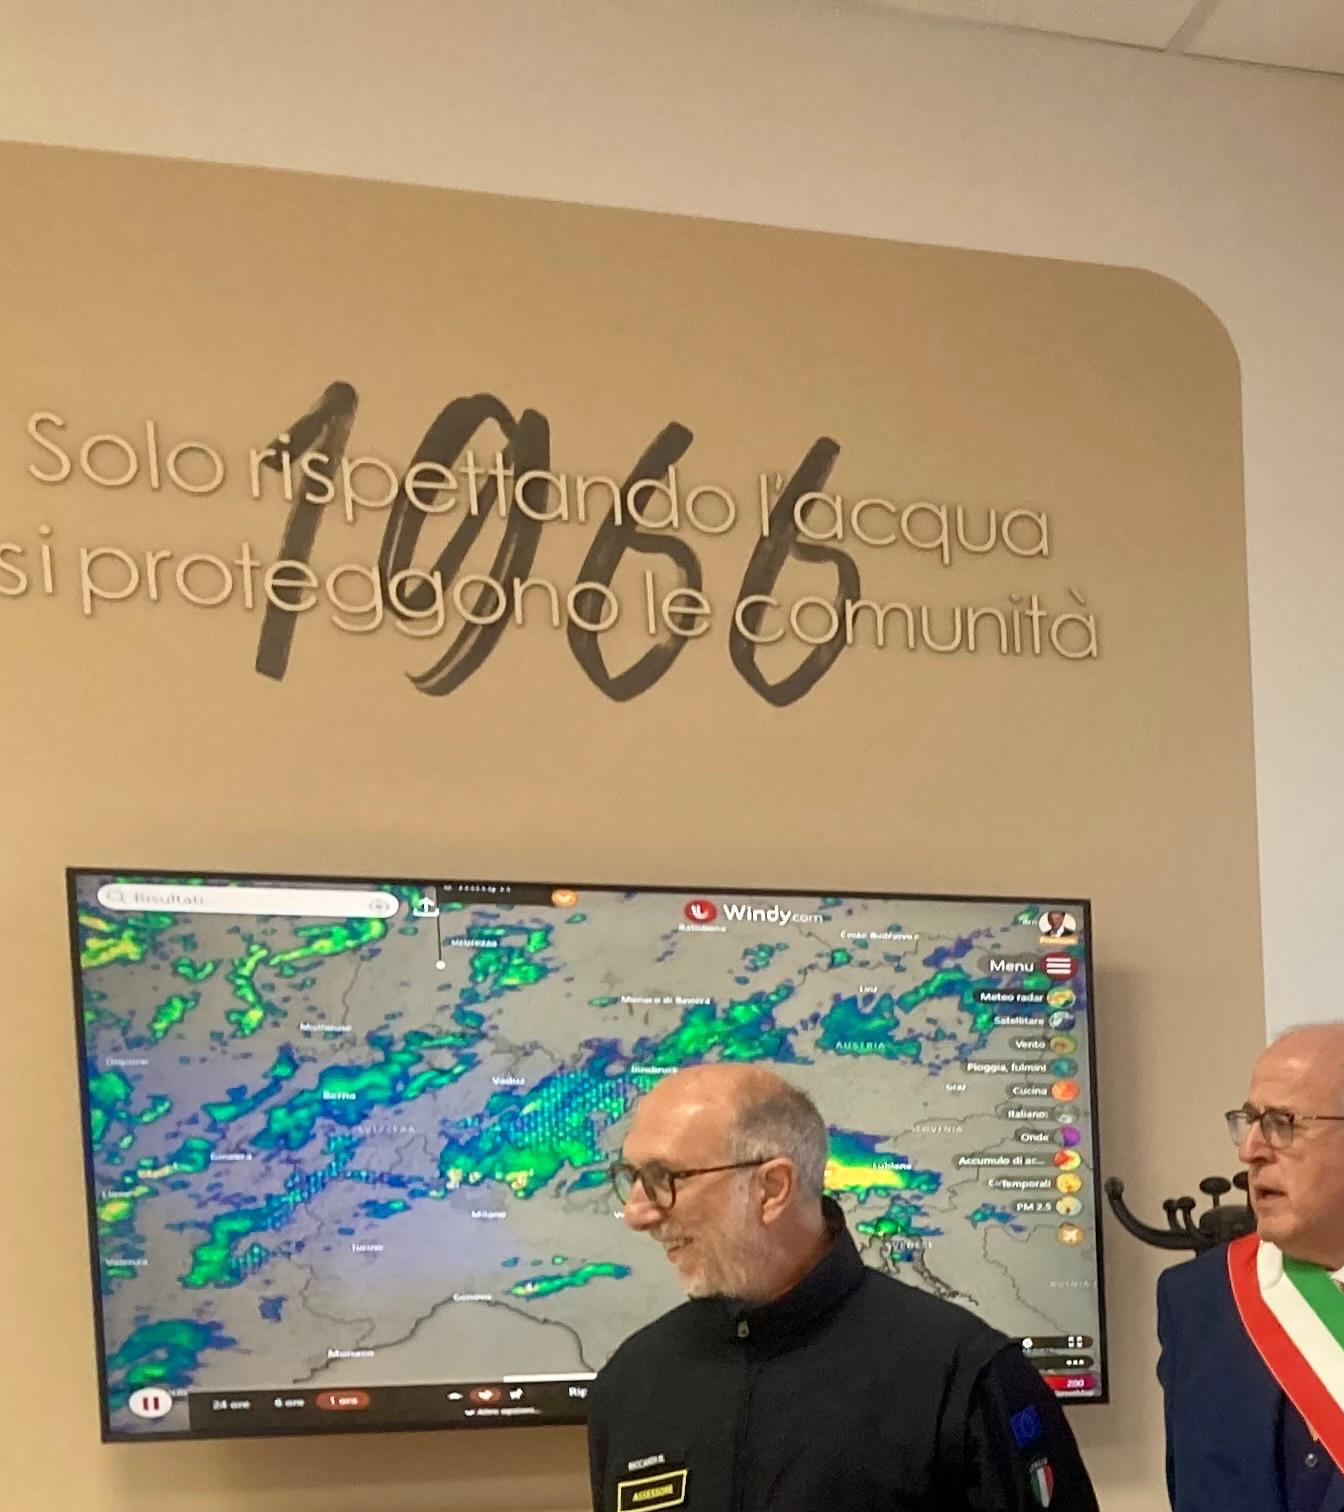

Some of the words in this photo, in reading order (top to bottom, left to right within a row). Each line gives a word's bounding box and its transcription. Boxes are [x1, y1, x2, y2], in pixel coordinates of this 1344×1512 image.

[26, 410, 226, 495] Solo
[247, 432, 738, 536] rispettando
[759, 472, 1051, 568] l'acqua
[0, 522, 54, 597] si
[81, 538, 621, 638] proteggono
[645, 571, 713, 639] le
[735, 584, 1101, 662] comunità
[990, 959, 1034, 973] Menu
[980, 992, 1014, 1002] Meteo
[1017, 993, 1044, 1002] radar
[1015, 1040, 1046, 1049] Vento
[1021, 1133, 1049, 1142] Onde
[1016, 1203, 1034, 1211] PM
